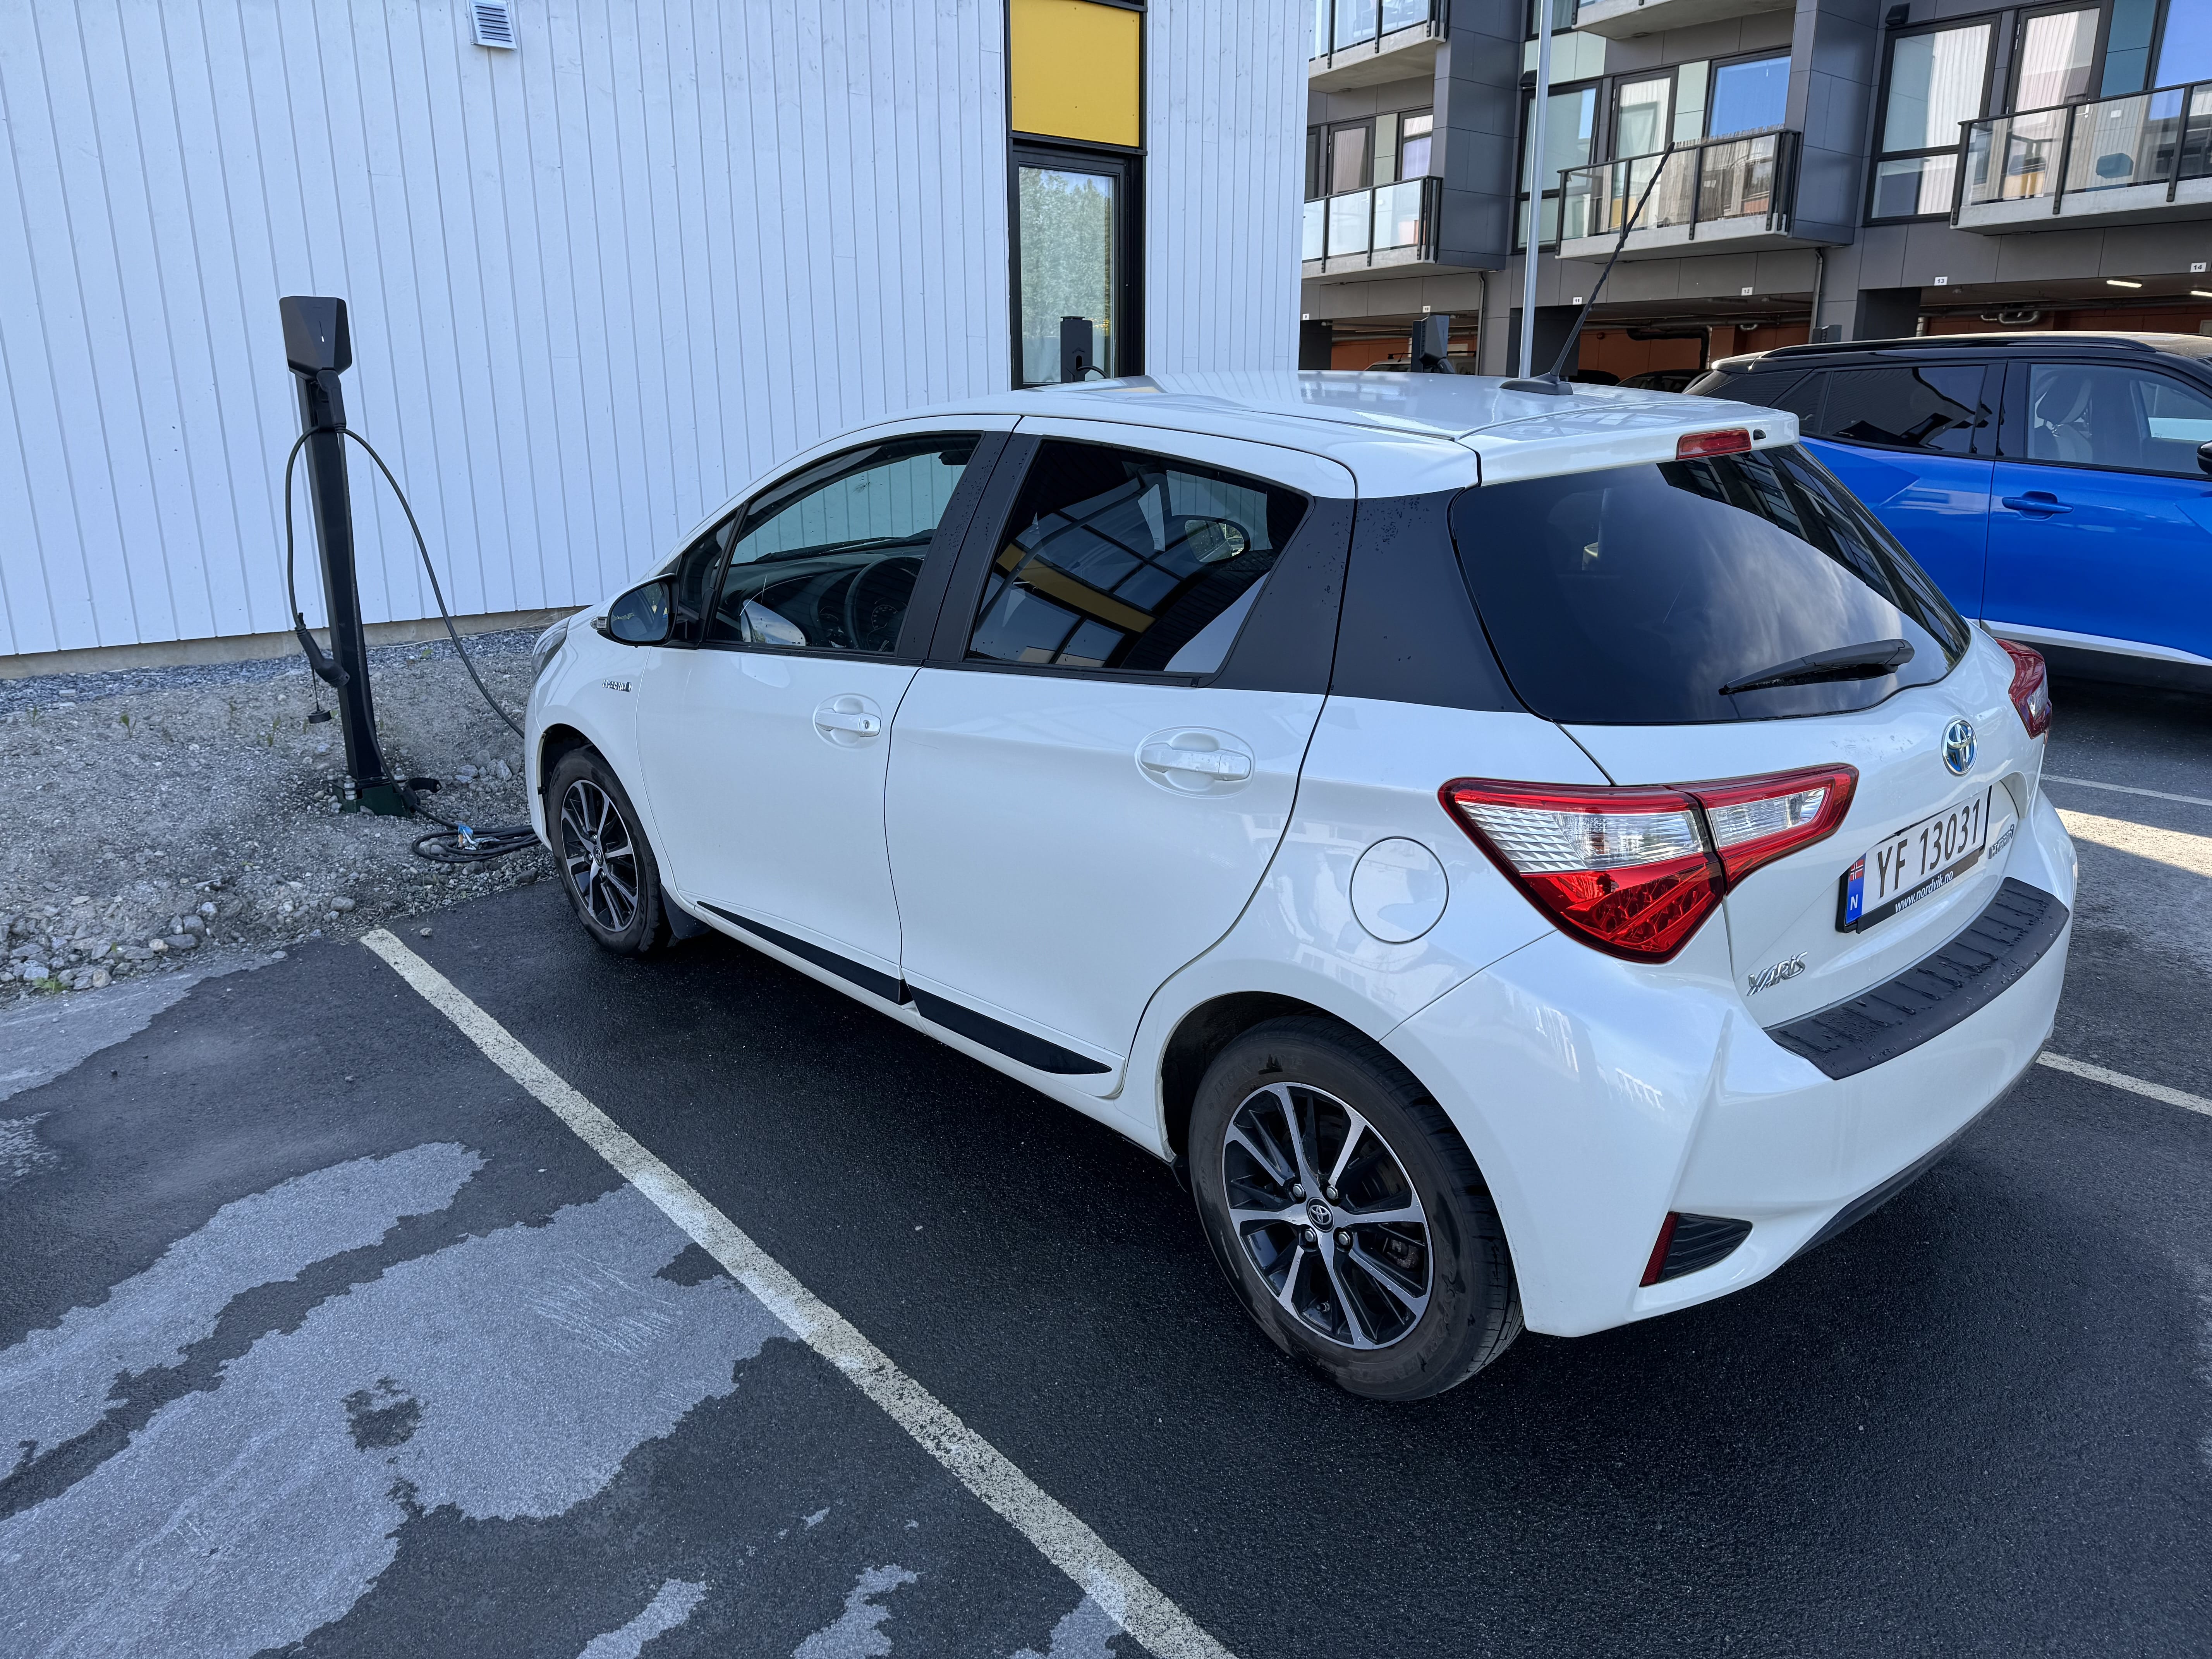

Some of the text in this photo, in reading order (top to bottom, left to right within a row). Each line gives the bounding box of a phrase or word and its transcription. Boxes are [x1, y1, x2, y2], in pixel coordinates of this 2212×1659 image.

[1877, 799, 1980, 898] YF 13031
[1850, 894, 1858, 911] N
[1894, 871, 1954, 913] www.nordvik.no
